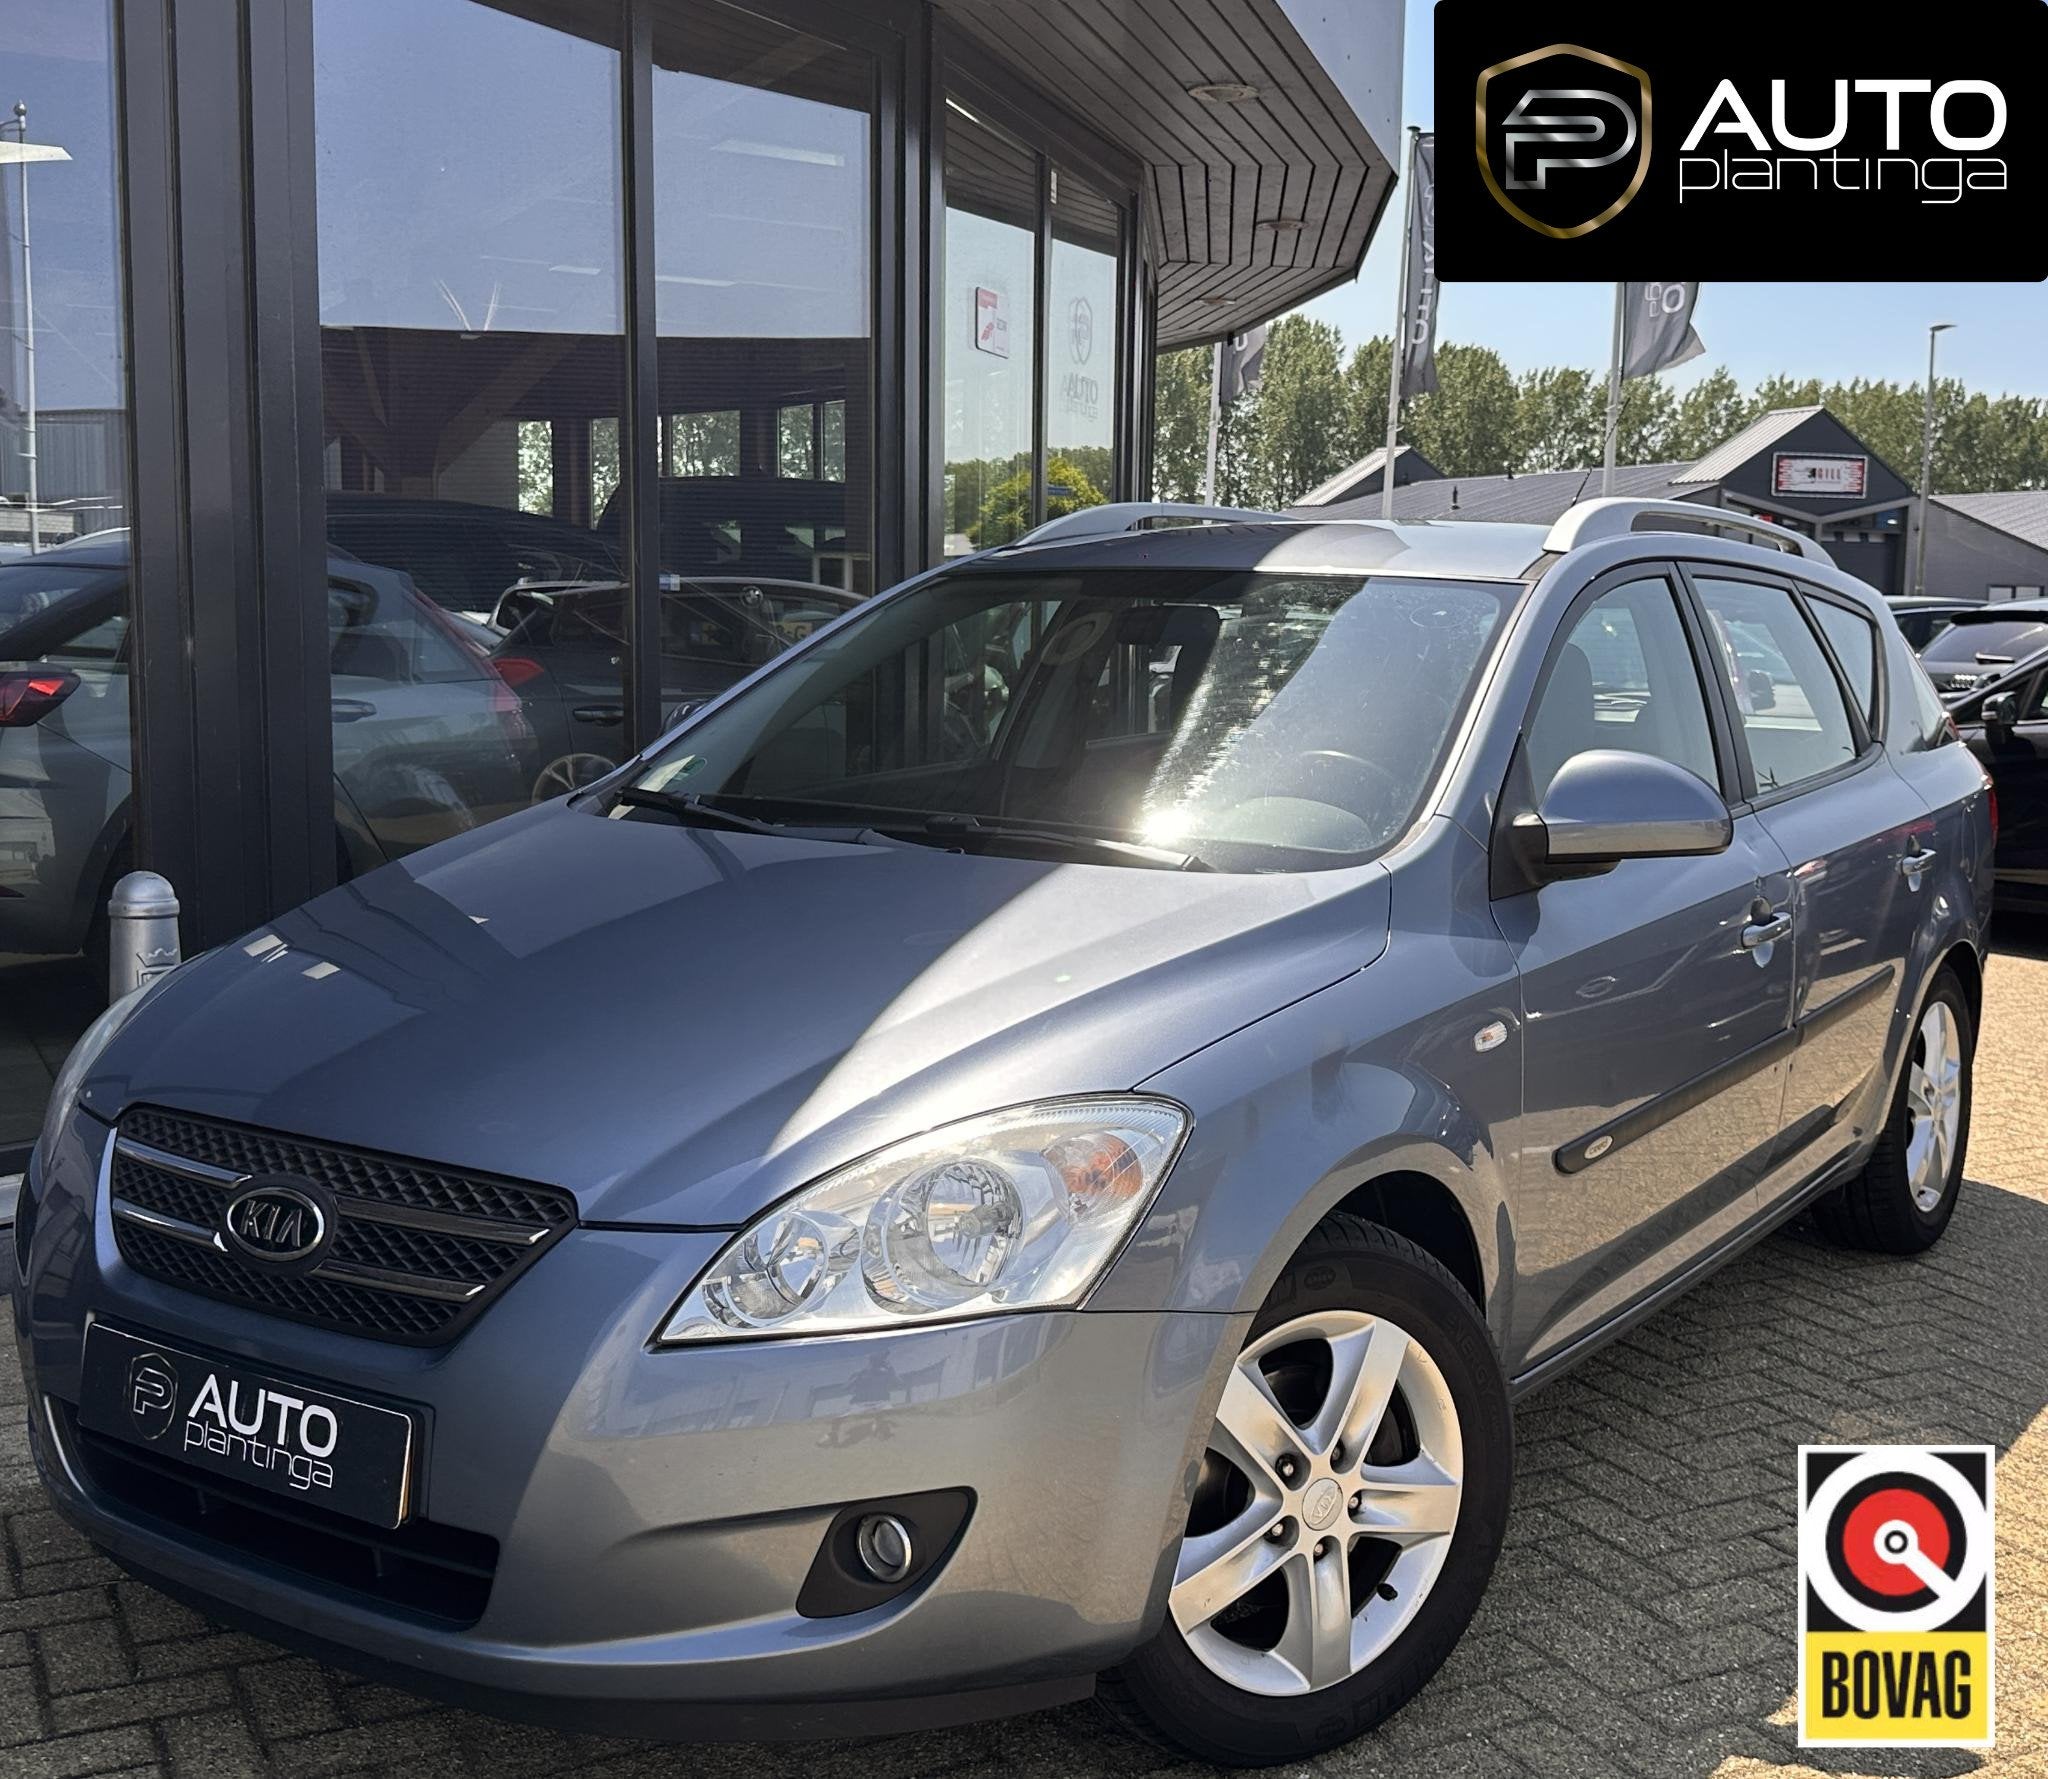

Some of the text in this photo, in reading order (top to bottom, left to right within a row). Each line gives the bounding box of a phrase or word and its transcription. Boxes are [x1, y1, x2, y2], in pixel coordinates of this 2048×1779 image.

[239, 1197, 303, 1248] KIA
[188, 1373, 338, 1458] AUTO
[184, 1419, 334, 1491] plantinga
